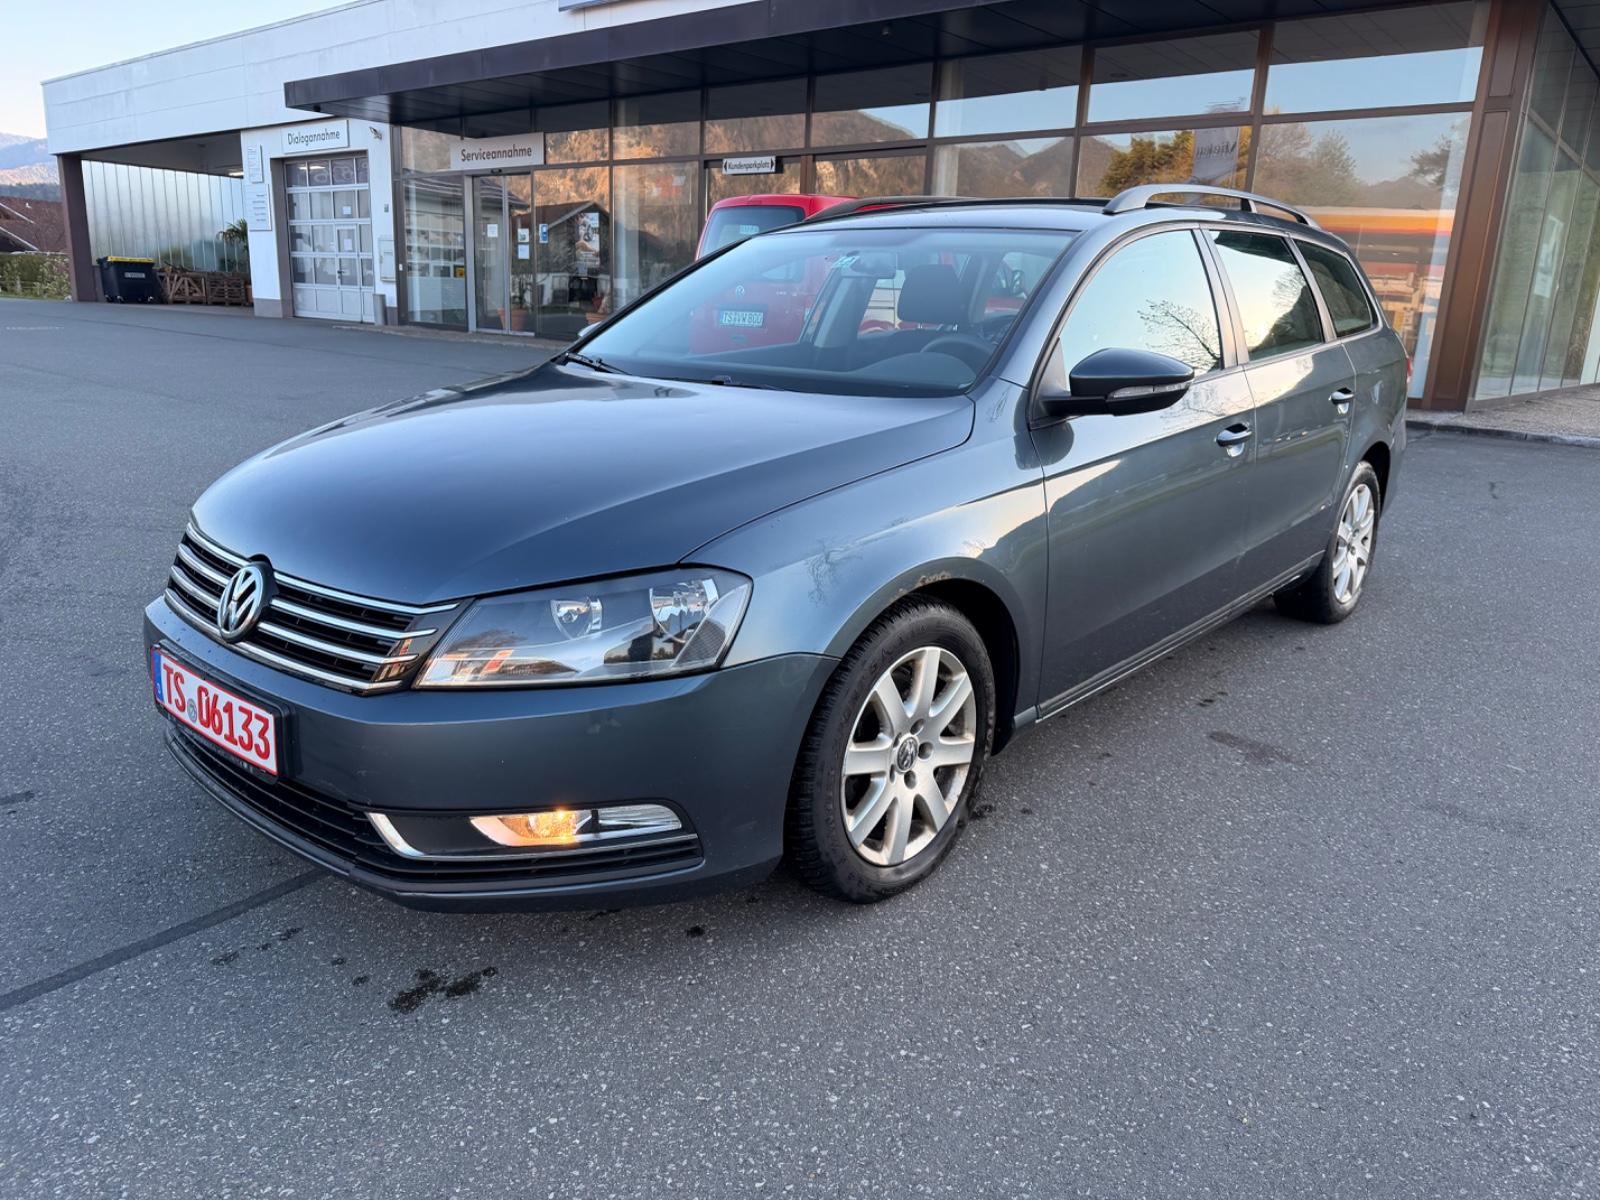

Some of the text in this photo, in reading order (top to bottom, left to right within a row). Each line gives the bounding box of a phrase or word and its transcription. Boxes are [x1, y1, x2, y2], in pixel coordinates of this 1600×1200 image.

[287, 128, 340, 146] Dialogannahme
[461, 144, 532, 161] Serviceannahme
[163, 663, 270, 760] TS 06133
